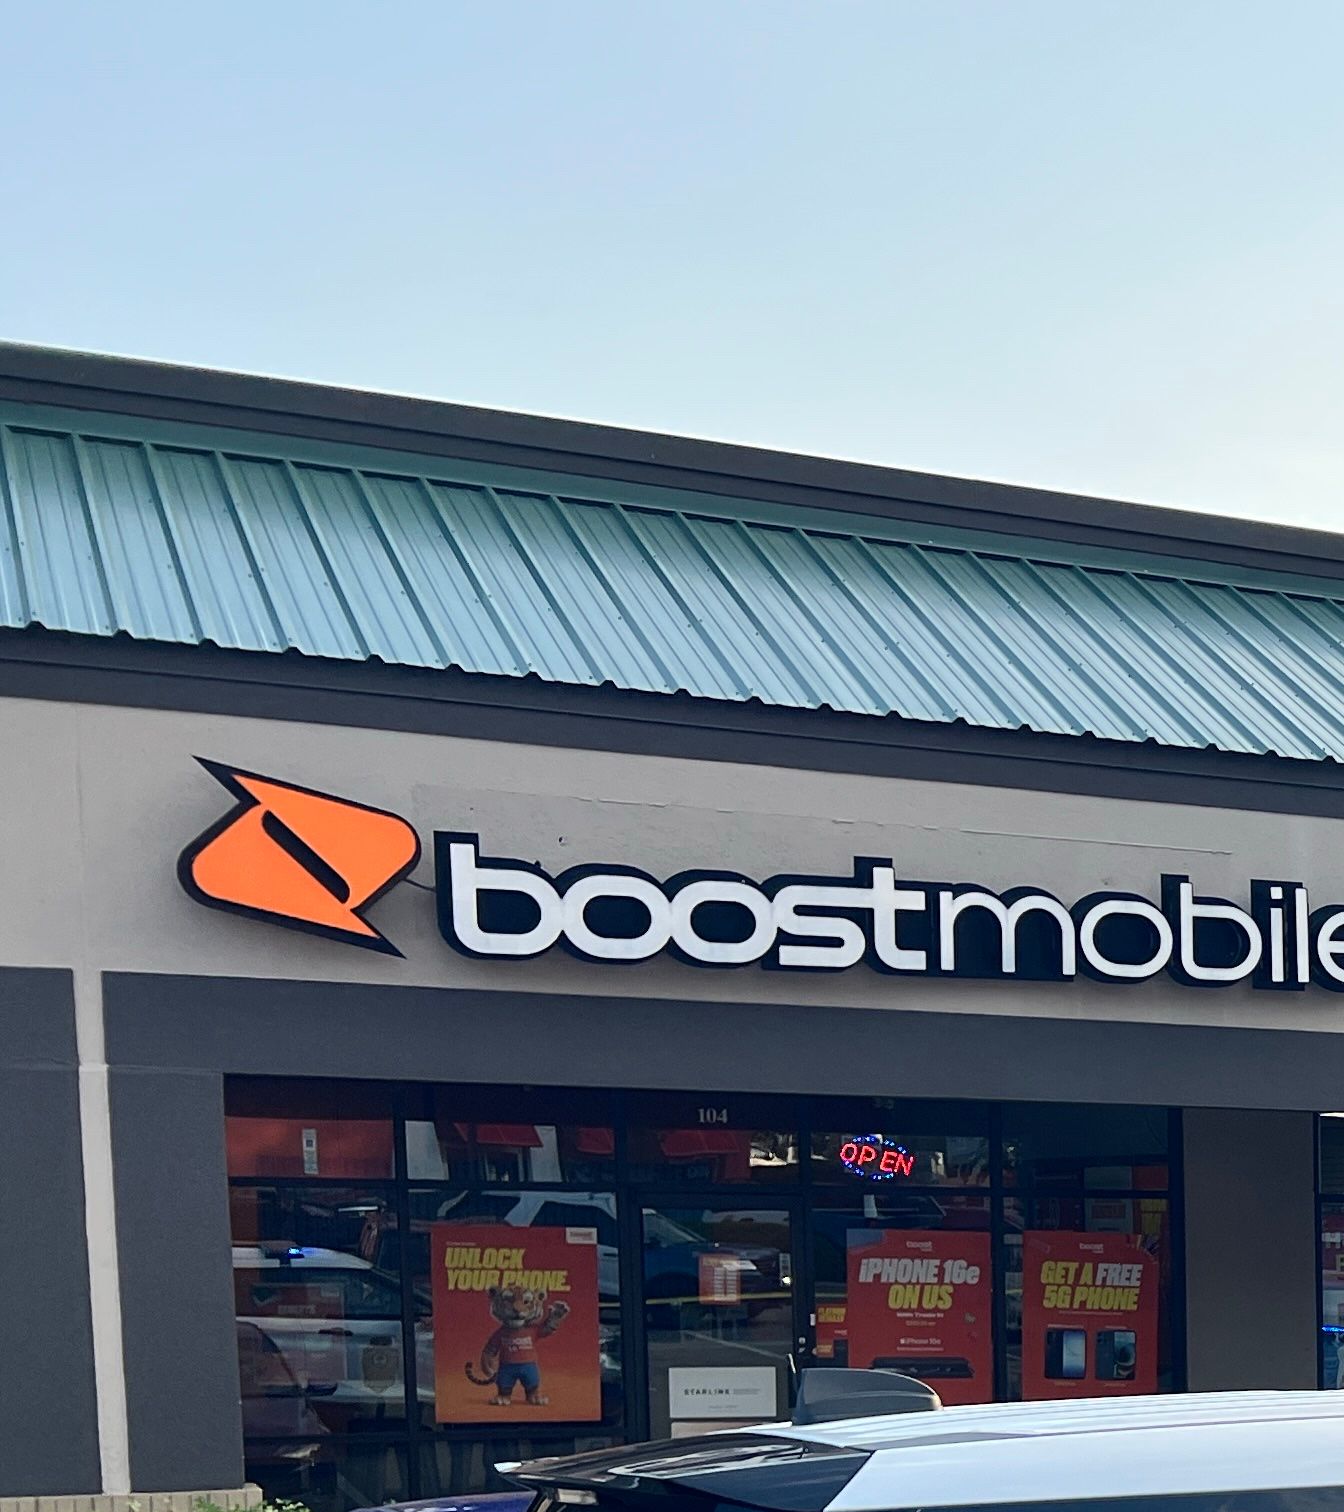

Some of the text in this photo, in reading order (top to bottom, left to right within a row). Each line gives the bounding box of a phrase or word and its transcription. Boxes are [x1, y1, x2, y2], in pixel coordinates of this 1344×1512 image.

[697, 1107, 728, 1124] 104
[839, 1142, 915, 1177] OPEN
[444, 1246, 526, 1269] UNLOCK
[447, 1270, 499, 1291] YOUR
[858, 1257, 981, 1285] iPHONE 16e
[1040, 1260, 1144, 1287] GET A FREE
[888, 1284, 954, 1310] ON US
[1042, 1285, 1140, 1311] 5G PHONE
